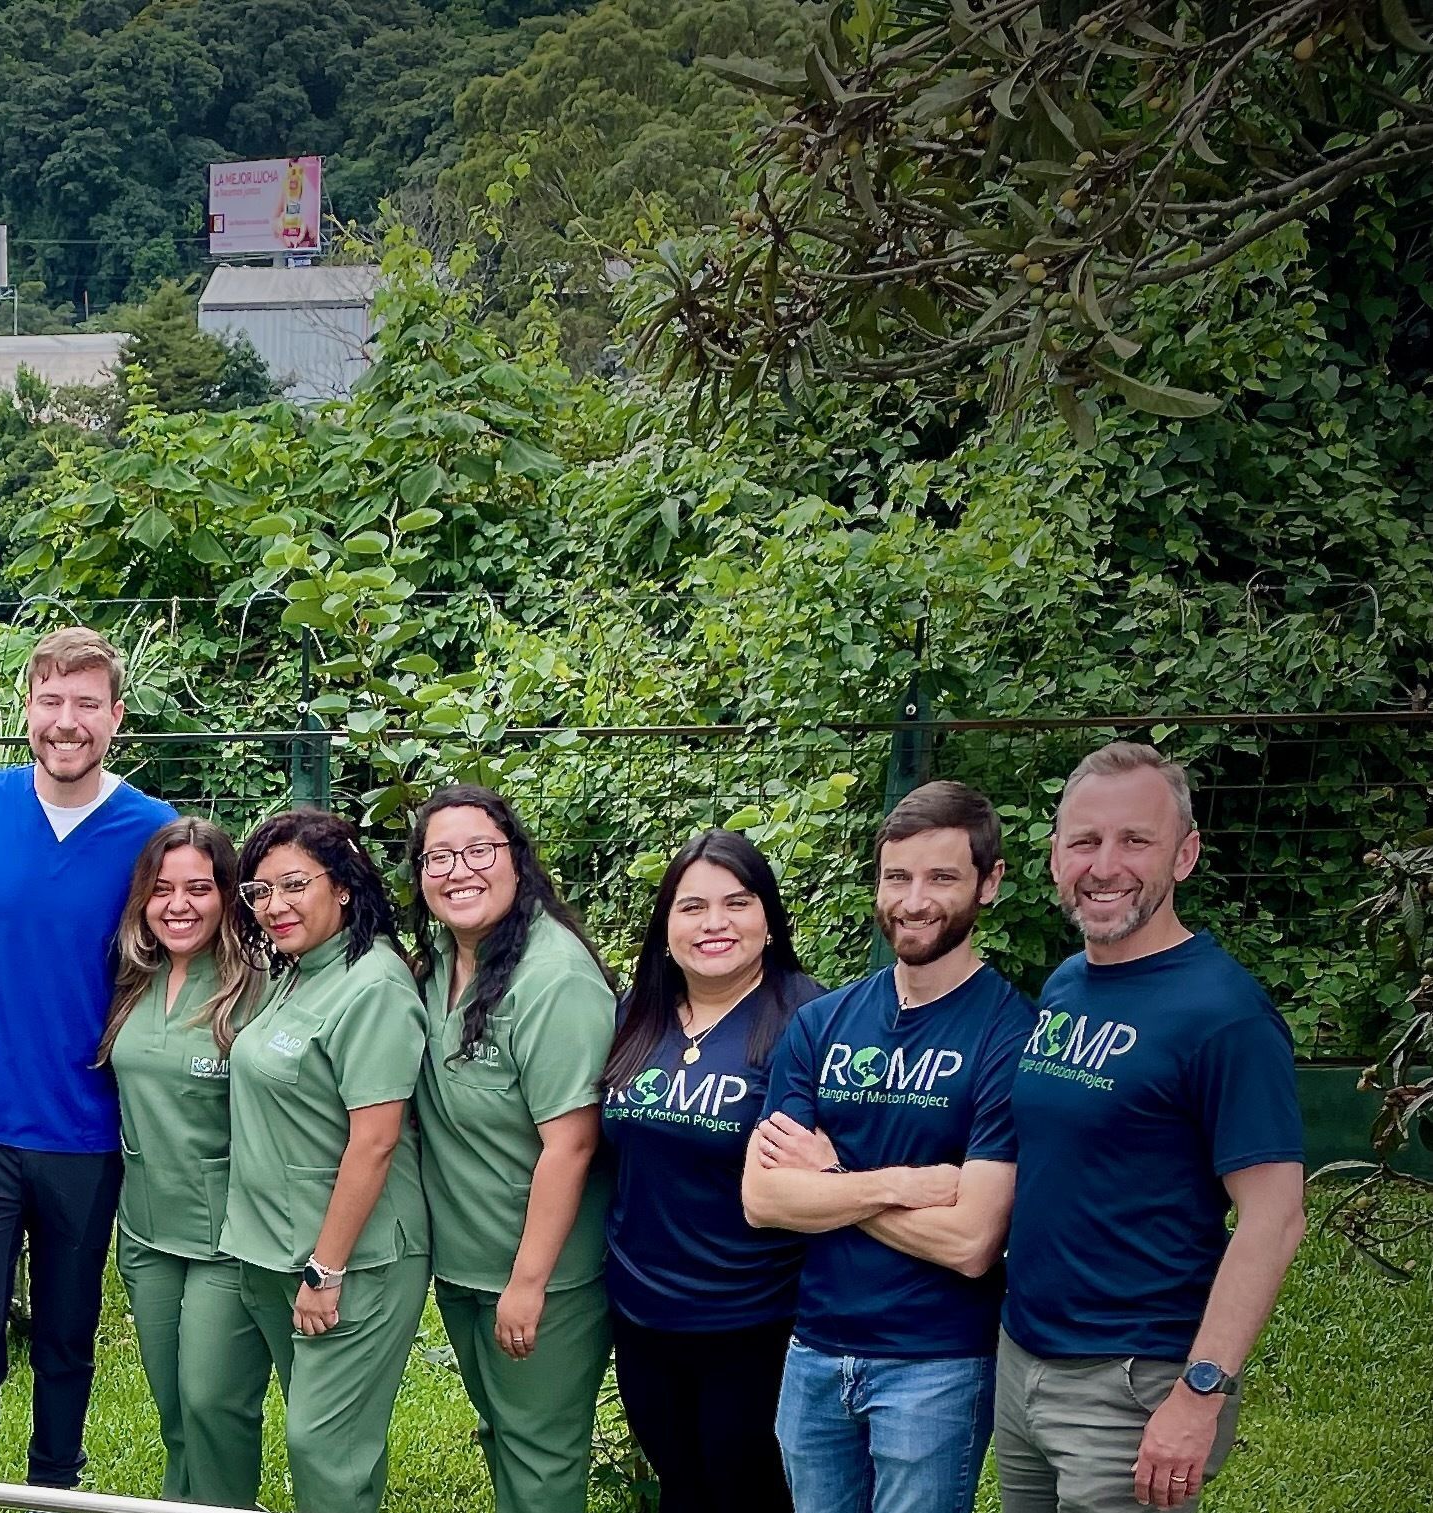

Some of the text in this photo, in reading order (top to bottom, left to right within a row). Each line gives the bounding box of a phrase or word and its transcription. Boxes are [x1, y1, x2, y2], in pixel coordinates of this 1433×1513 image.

[226, 172, 252, 185] MEJOR
[253, 169, 279, 184] LUCHA
[1024, 1009, 1137, 1071] ROMP
[819, 1043, 963, 1090] ROMP
[1076, 1074, 1115, 1091] Project
[818, 1087, 851, 1103] Range
[852, 1089, 866, 1105] of
[906, 1092, 950, 1109] Project
[631, 1106, 646, 1121] of
[647, 1109, 691, 1124] Motion
[693, 1114, 742, 1133] Project
